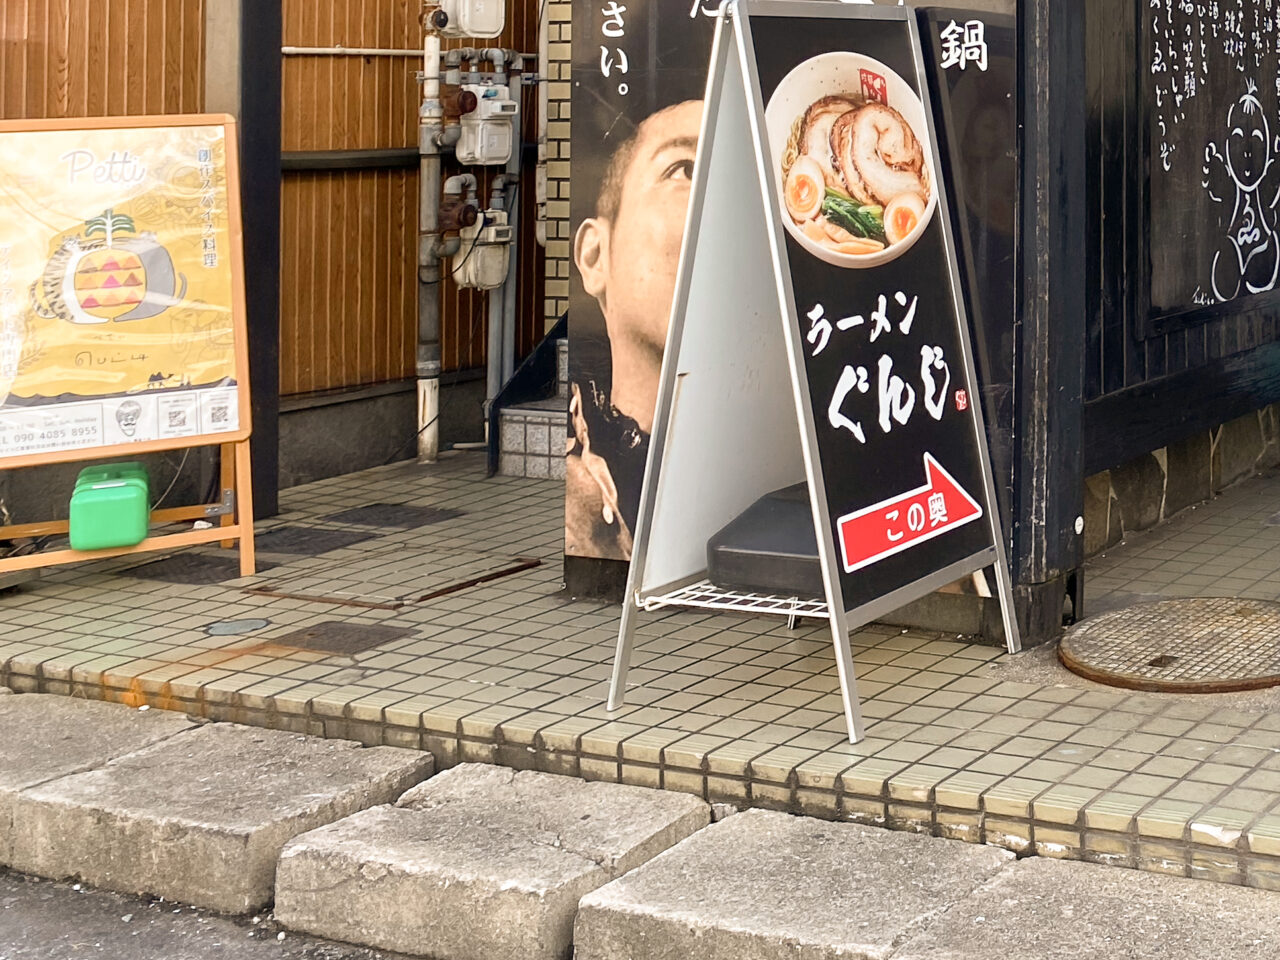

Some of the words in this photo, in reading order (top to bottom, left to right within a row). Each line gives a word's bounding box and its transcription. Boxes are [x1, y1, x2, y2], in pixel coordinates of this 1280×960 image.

[62, 149, 147, 188] Petti
[806, 289, 919, 357] ラーメン
[828, 344, 951, 444] ぐんじ
[14, 433, 34, 443] 090
[39, 429, 66, 440] 4085
[71, 425, 98, 437] 8955
[885, 490, 950, 543] この奥
